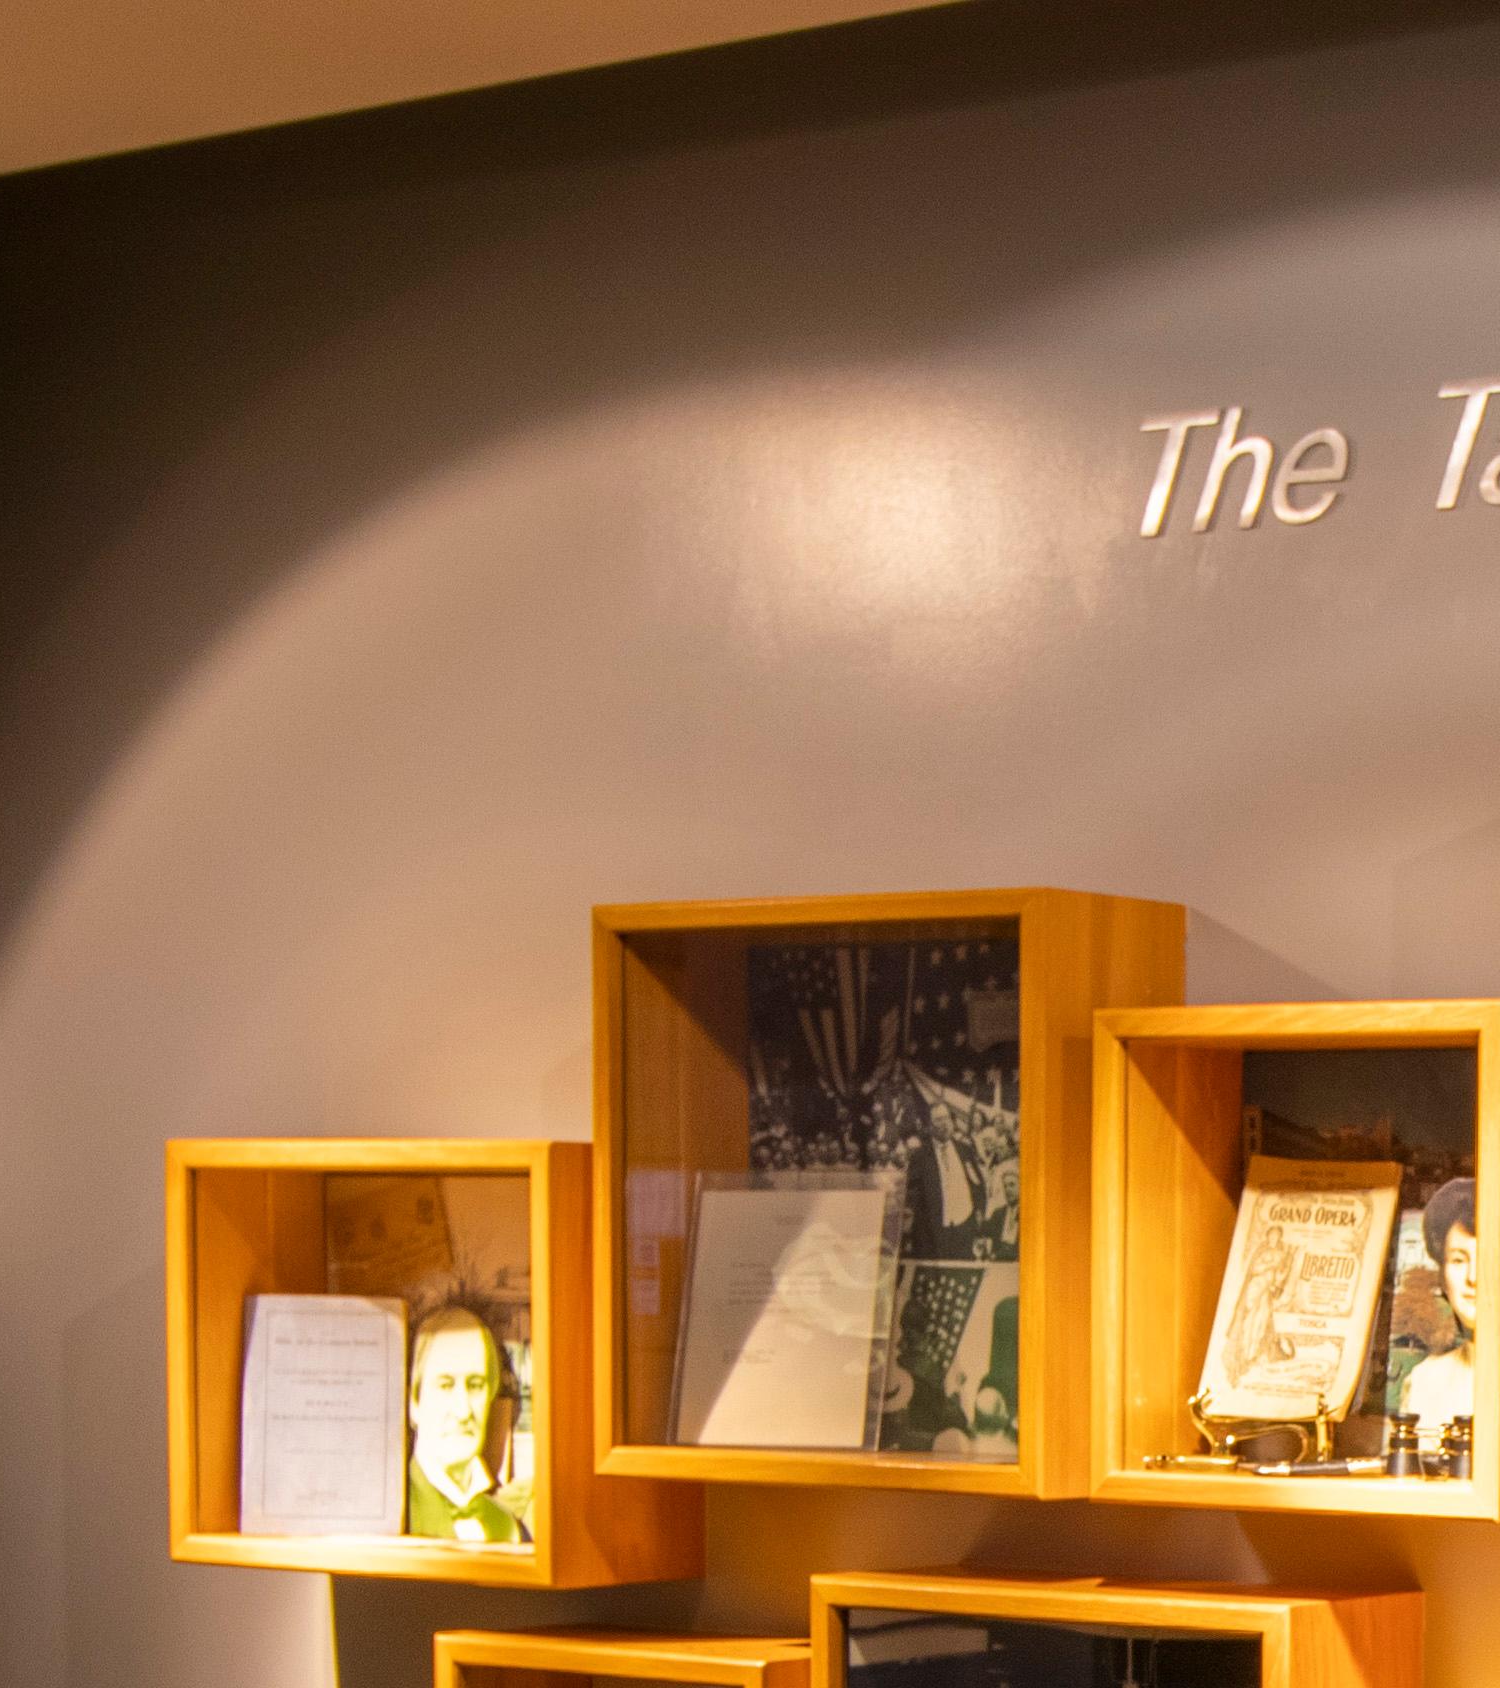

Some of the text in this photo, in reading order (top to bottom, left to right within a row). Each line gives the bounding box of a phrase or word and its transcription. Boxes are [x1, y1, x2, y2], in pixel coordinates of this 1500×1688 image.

[1139, 406, 1352, 538] The
[1269, 1203, 1357, 1227] GRAND OPERA
[1300, 1252, 1355, 1282] LIBRETTO
